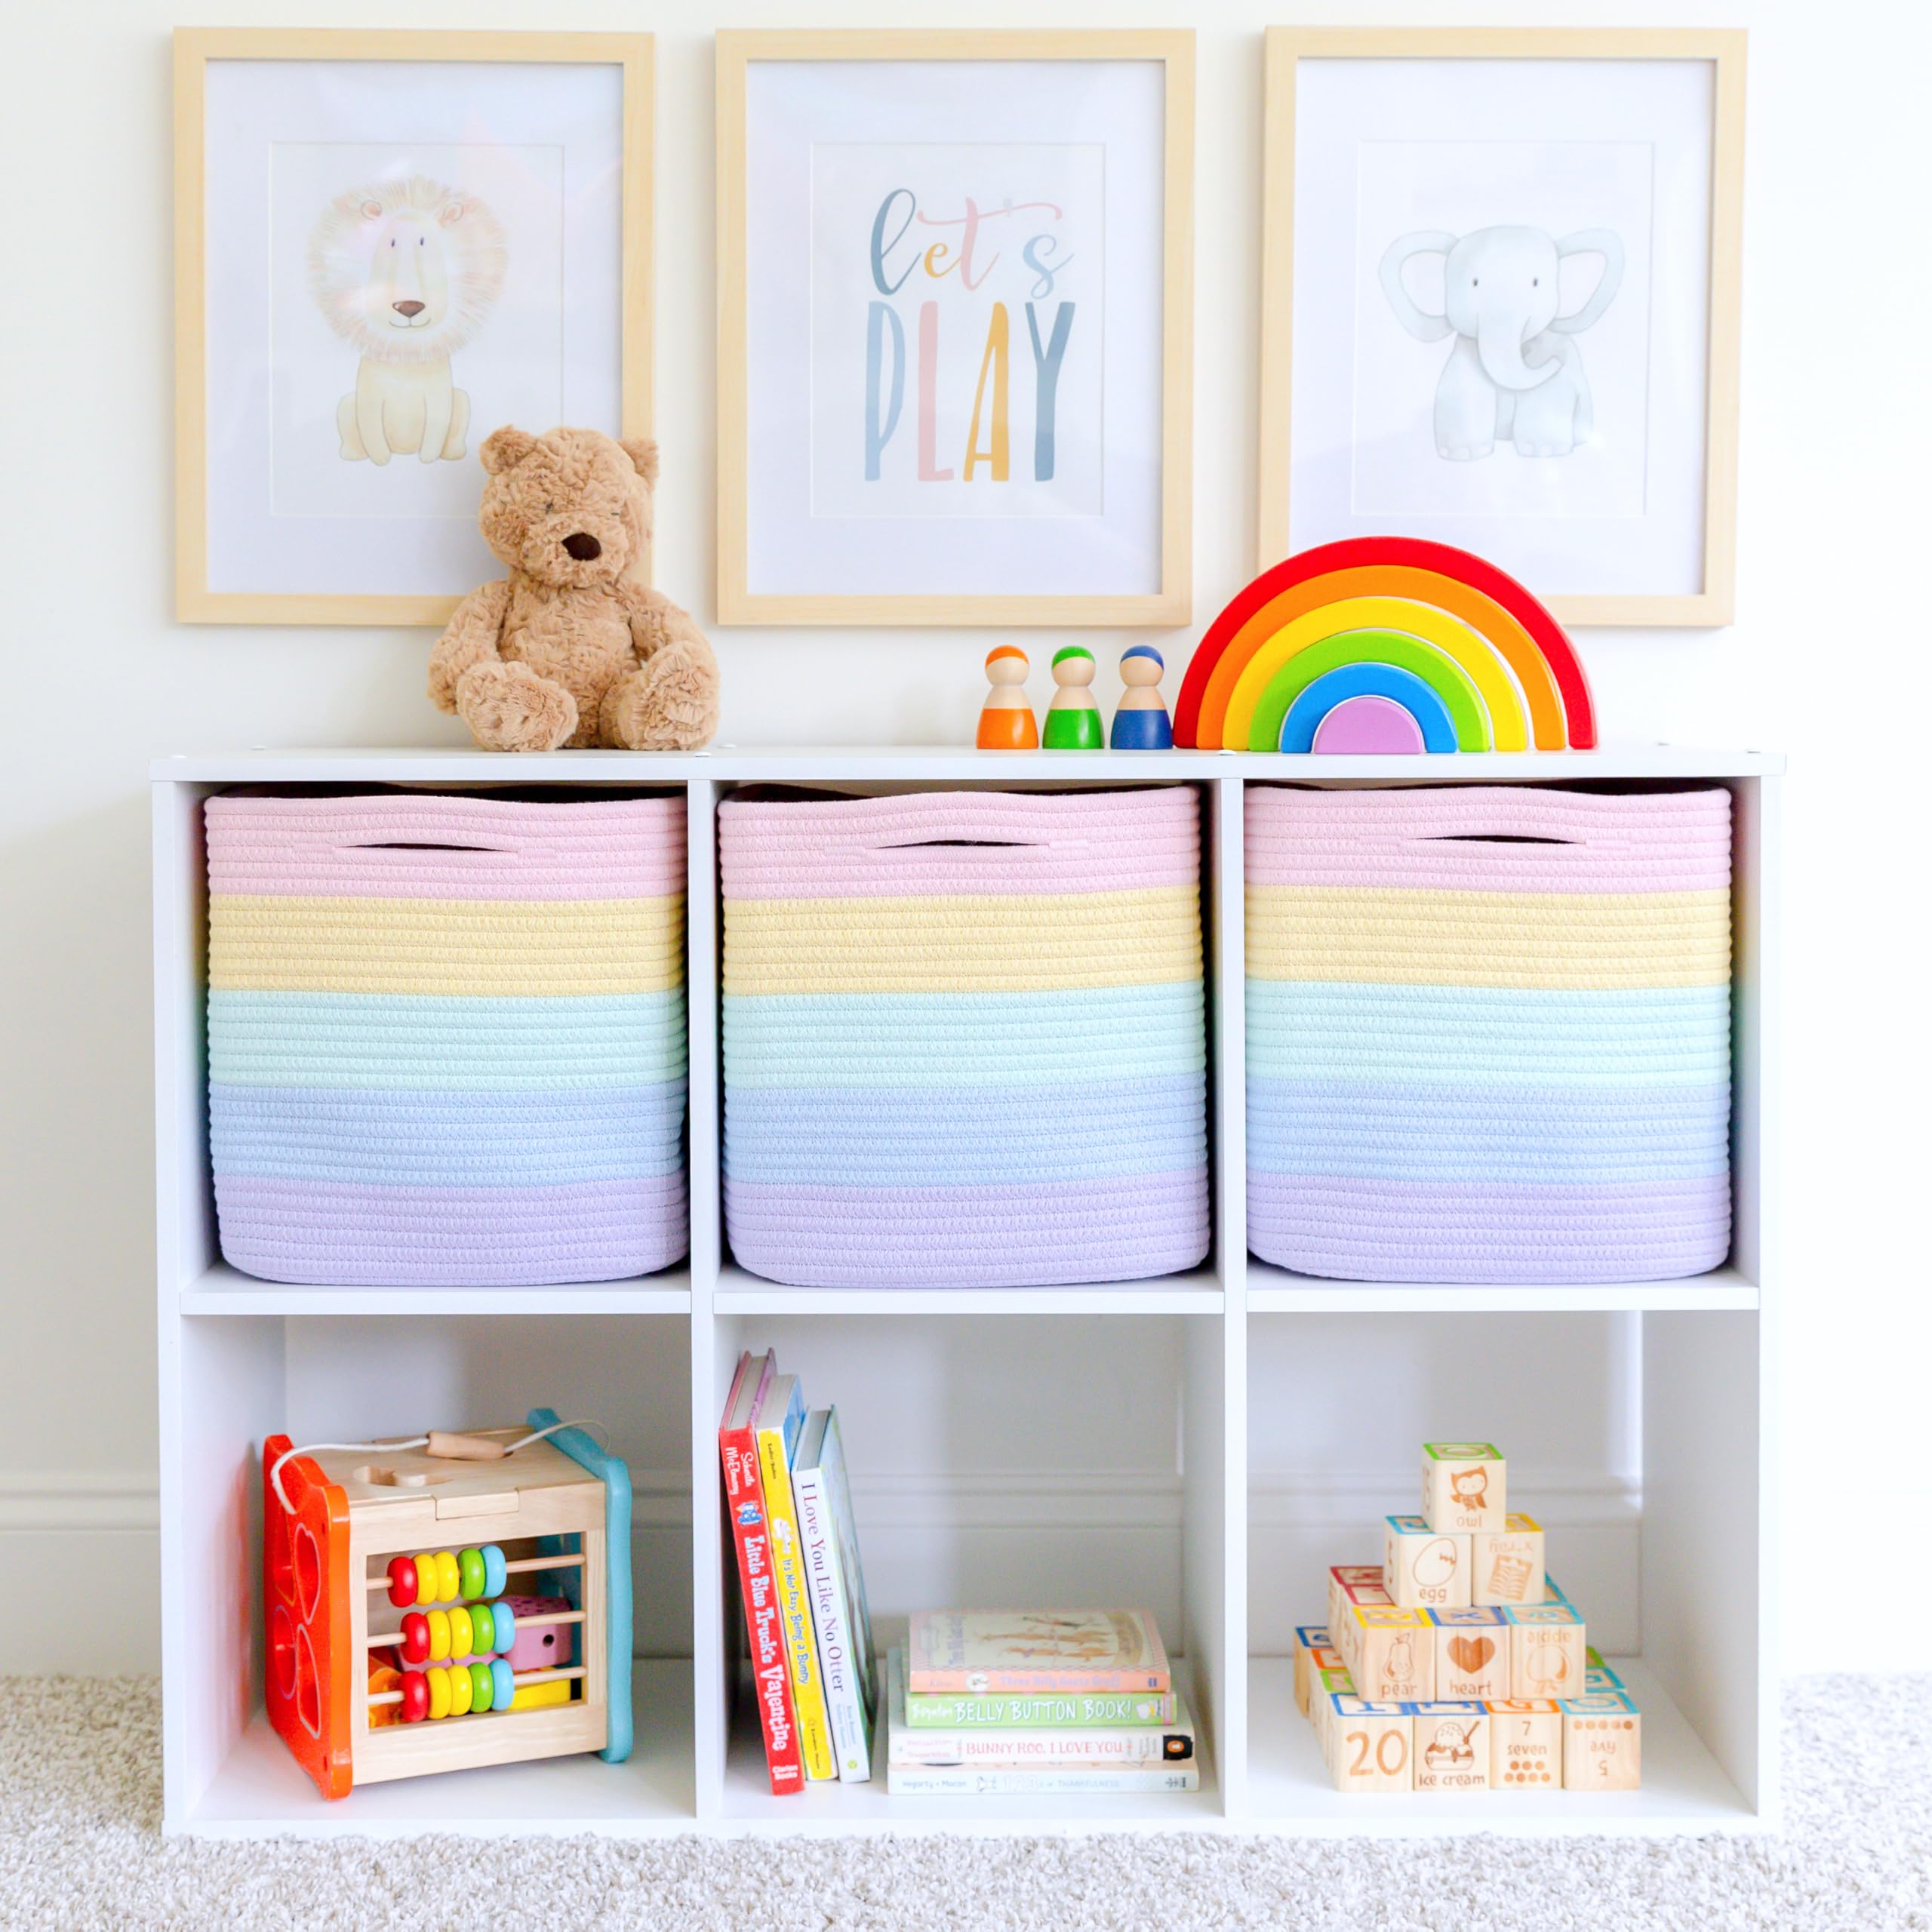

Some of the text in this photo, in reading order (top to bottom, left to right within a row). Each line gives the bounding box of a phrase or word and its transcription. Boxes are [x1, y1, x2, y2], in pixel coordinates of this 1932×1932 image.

[870, 189, 1075, 299] let's
[865, 301, 1075, 481] PLAY
[1456, 1515, 1482, 1527] owl
[782, 1558, 793, 1571] It's
[785, 1574, 795, 1589] Not
[801, 1483, 844, 1692] I Love You Like No Otter
[787, 1591, 799, 1611] Easy
[1419, 1587, 1447, 1603] egg
[790, 1614, 804, 1641] Being
[744, 1535, 791, 1751] Little Blue Truck's Valentine
[796, 1653, 810, 1684] Bunny
[1381, 1683, 1417, 1698] pear
[1449, 1680, 1492, 1696] heart
[954, 1701, 1004, 1723] BELLY
[1009, 1700, 1075, 1721] BUTTON
[1082, 1699, 1131, 1721] BOOK!
[1521, 1721, 1531, 1736] 7
[966, 1742, 1014, 1755] BUNNY
[1050, 1742, 1055, 1754] I
[1059, 1742, 1091, 1755] LOVE
[1094, 1742, 1123, 1754] YOU
[1346, 1728, 1408, 1776] 20
[1507, 1744, 1546, 1755] seven
[1598, 1760, 1608, 1776] 5
[1418, 1774, 1484, 1786] ice cream
